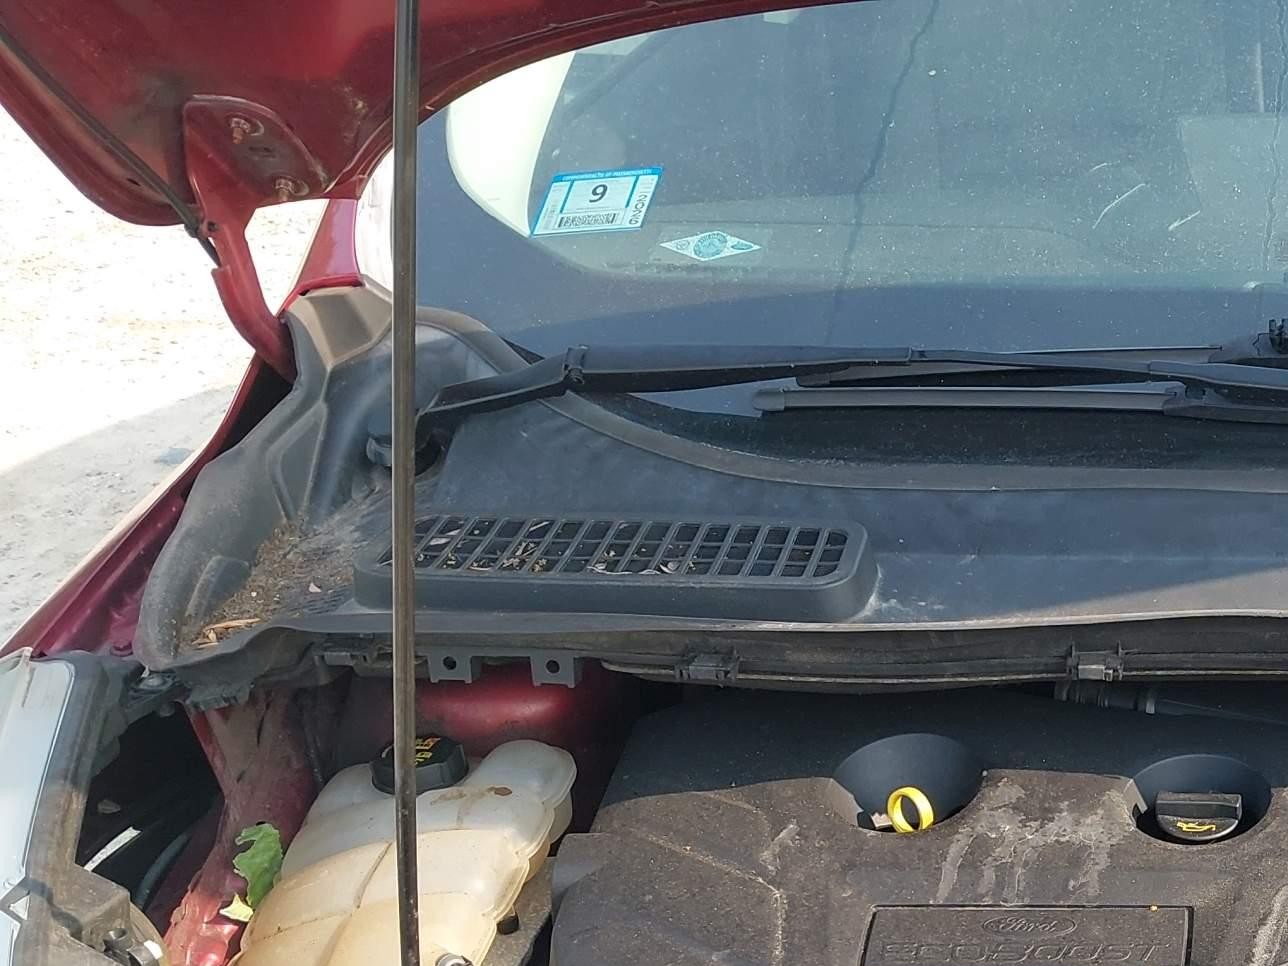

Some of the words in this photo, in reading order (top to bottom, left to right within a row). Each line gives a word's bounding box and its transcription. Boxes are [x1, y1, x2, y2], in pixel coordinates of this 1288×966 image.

[589, 184, 608, 203] 9
[1000, 916, 1059, 933] Ford
[884, 943, 1170, 963] ECOBOOST
